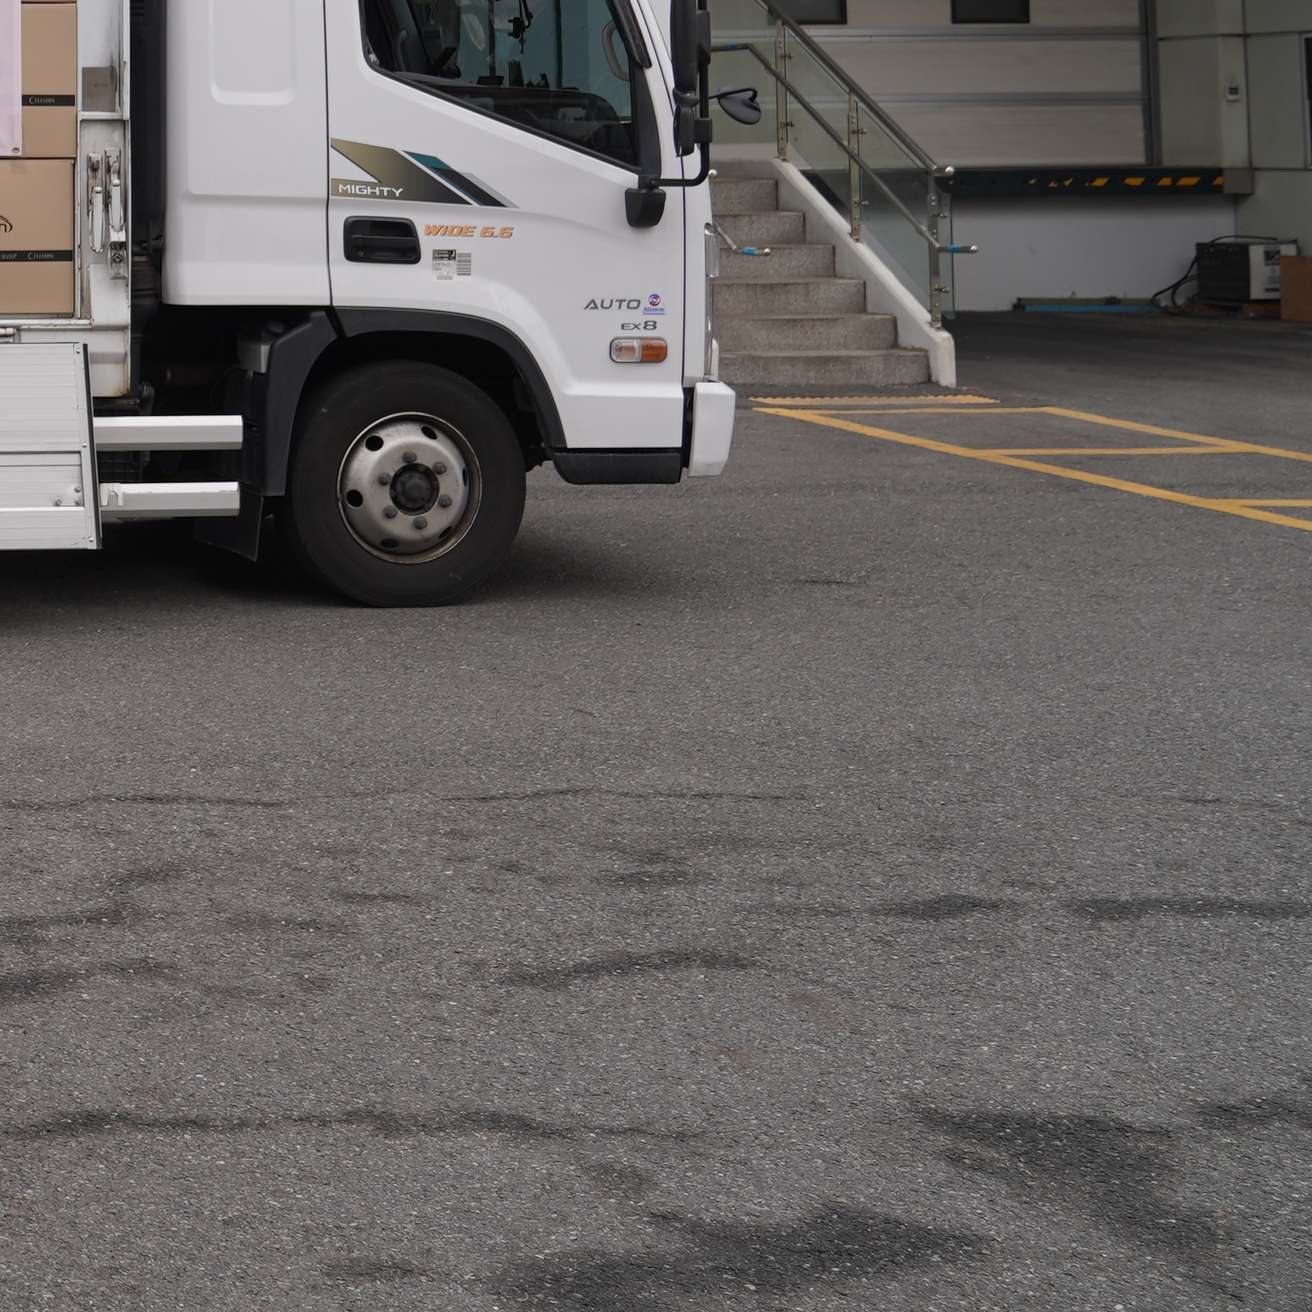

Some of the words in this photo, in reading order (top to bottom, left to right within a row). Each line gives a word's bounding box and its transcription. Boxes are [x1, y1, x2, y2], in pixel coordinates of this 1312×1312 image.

[338, 183, 404, 198] MIGHTY
[424, 224, 475, 239] WIDE
[583, 298, 642, 310] AUTO
